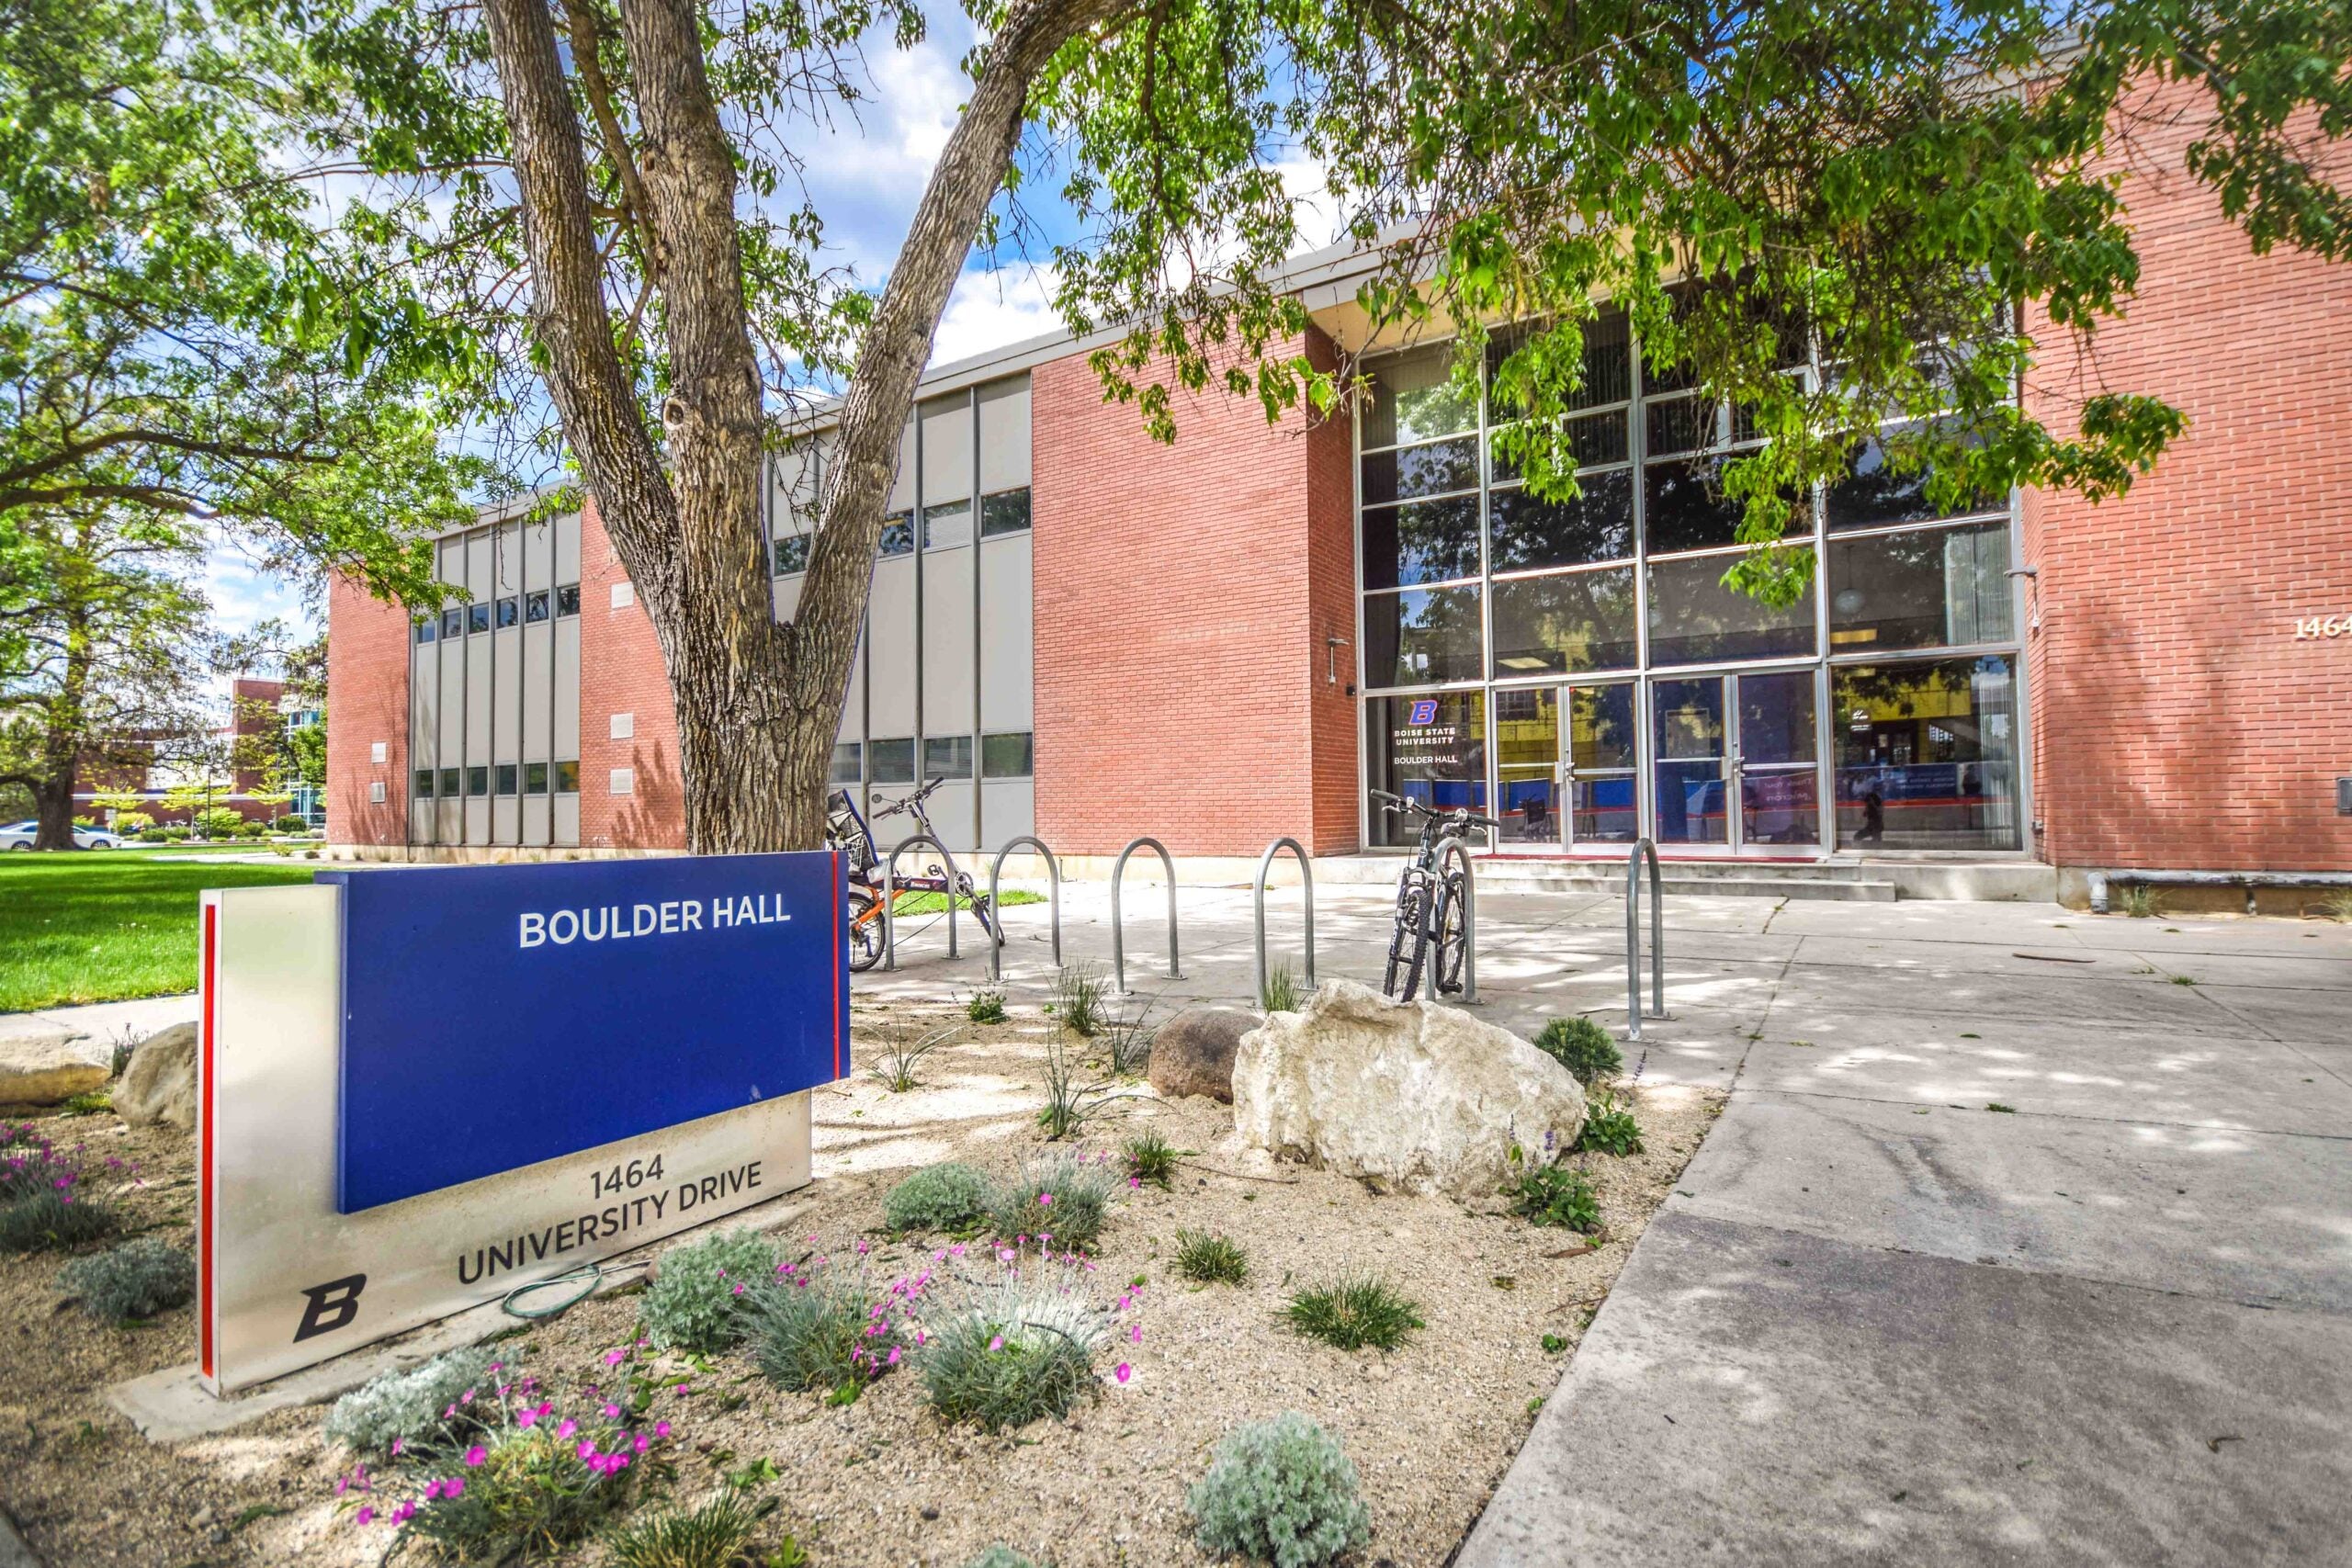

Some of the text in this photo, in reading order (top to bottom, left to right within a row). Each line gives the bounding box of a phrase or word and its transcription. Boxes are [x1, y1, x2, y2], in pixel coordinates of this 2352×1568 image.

[1408, 700, 1438, 725] B
[1395, 755, 1457, 764] BOULDER HALL
[1396, 737, 1453, 745] UNIVERSITY
[519, 893, 791, 949] BOULDER HALL
[591, 1154, 664, 1199] 1464
[458, 1160, 763, 1285] UNIVERSITY DRIVE
[292, 1272, 368, 1345] B
